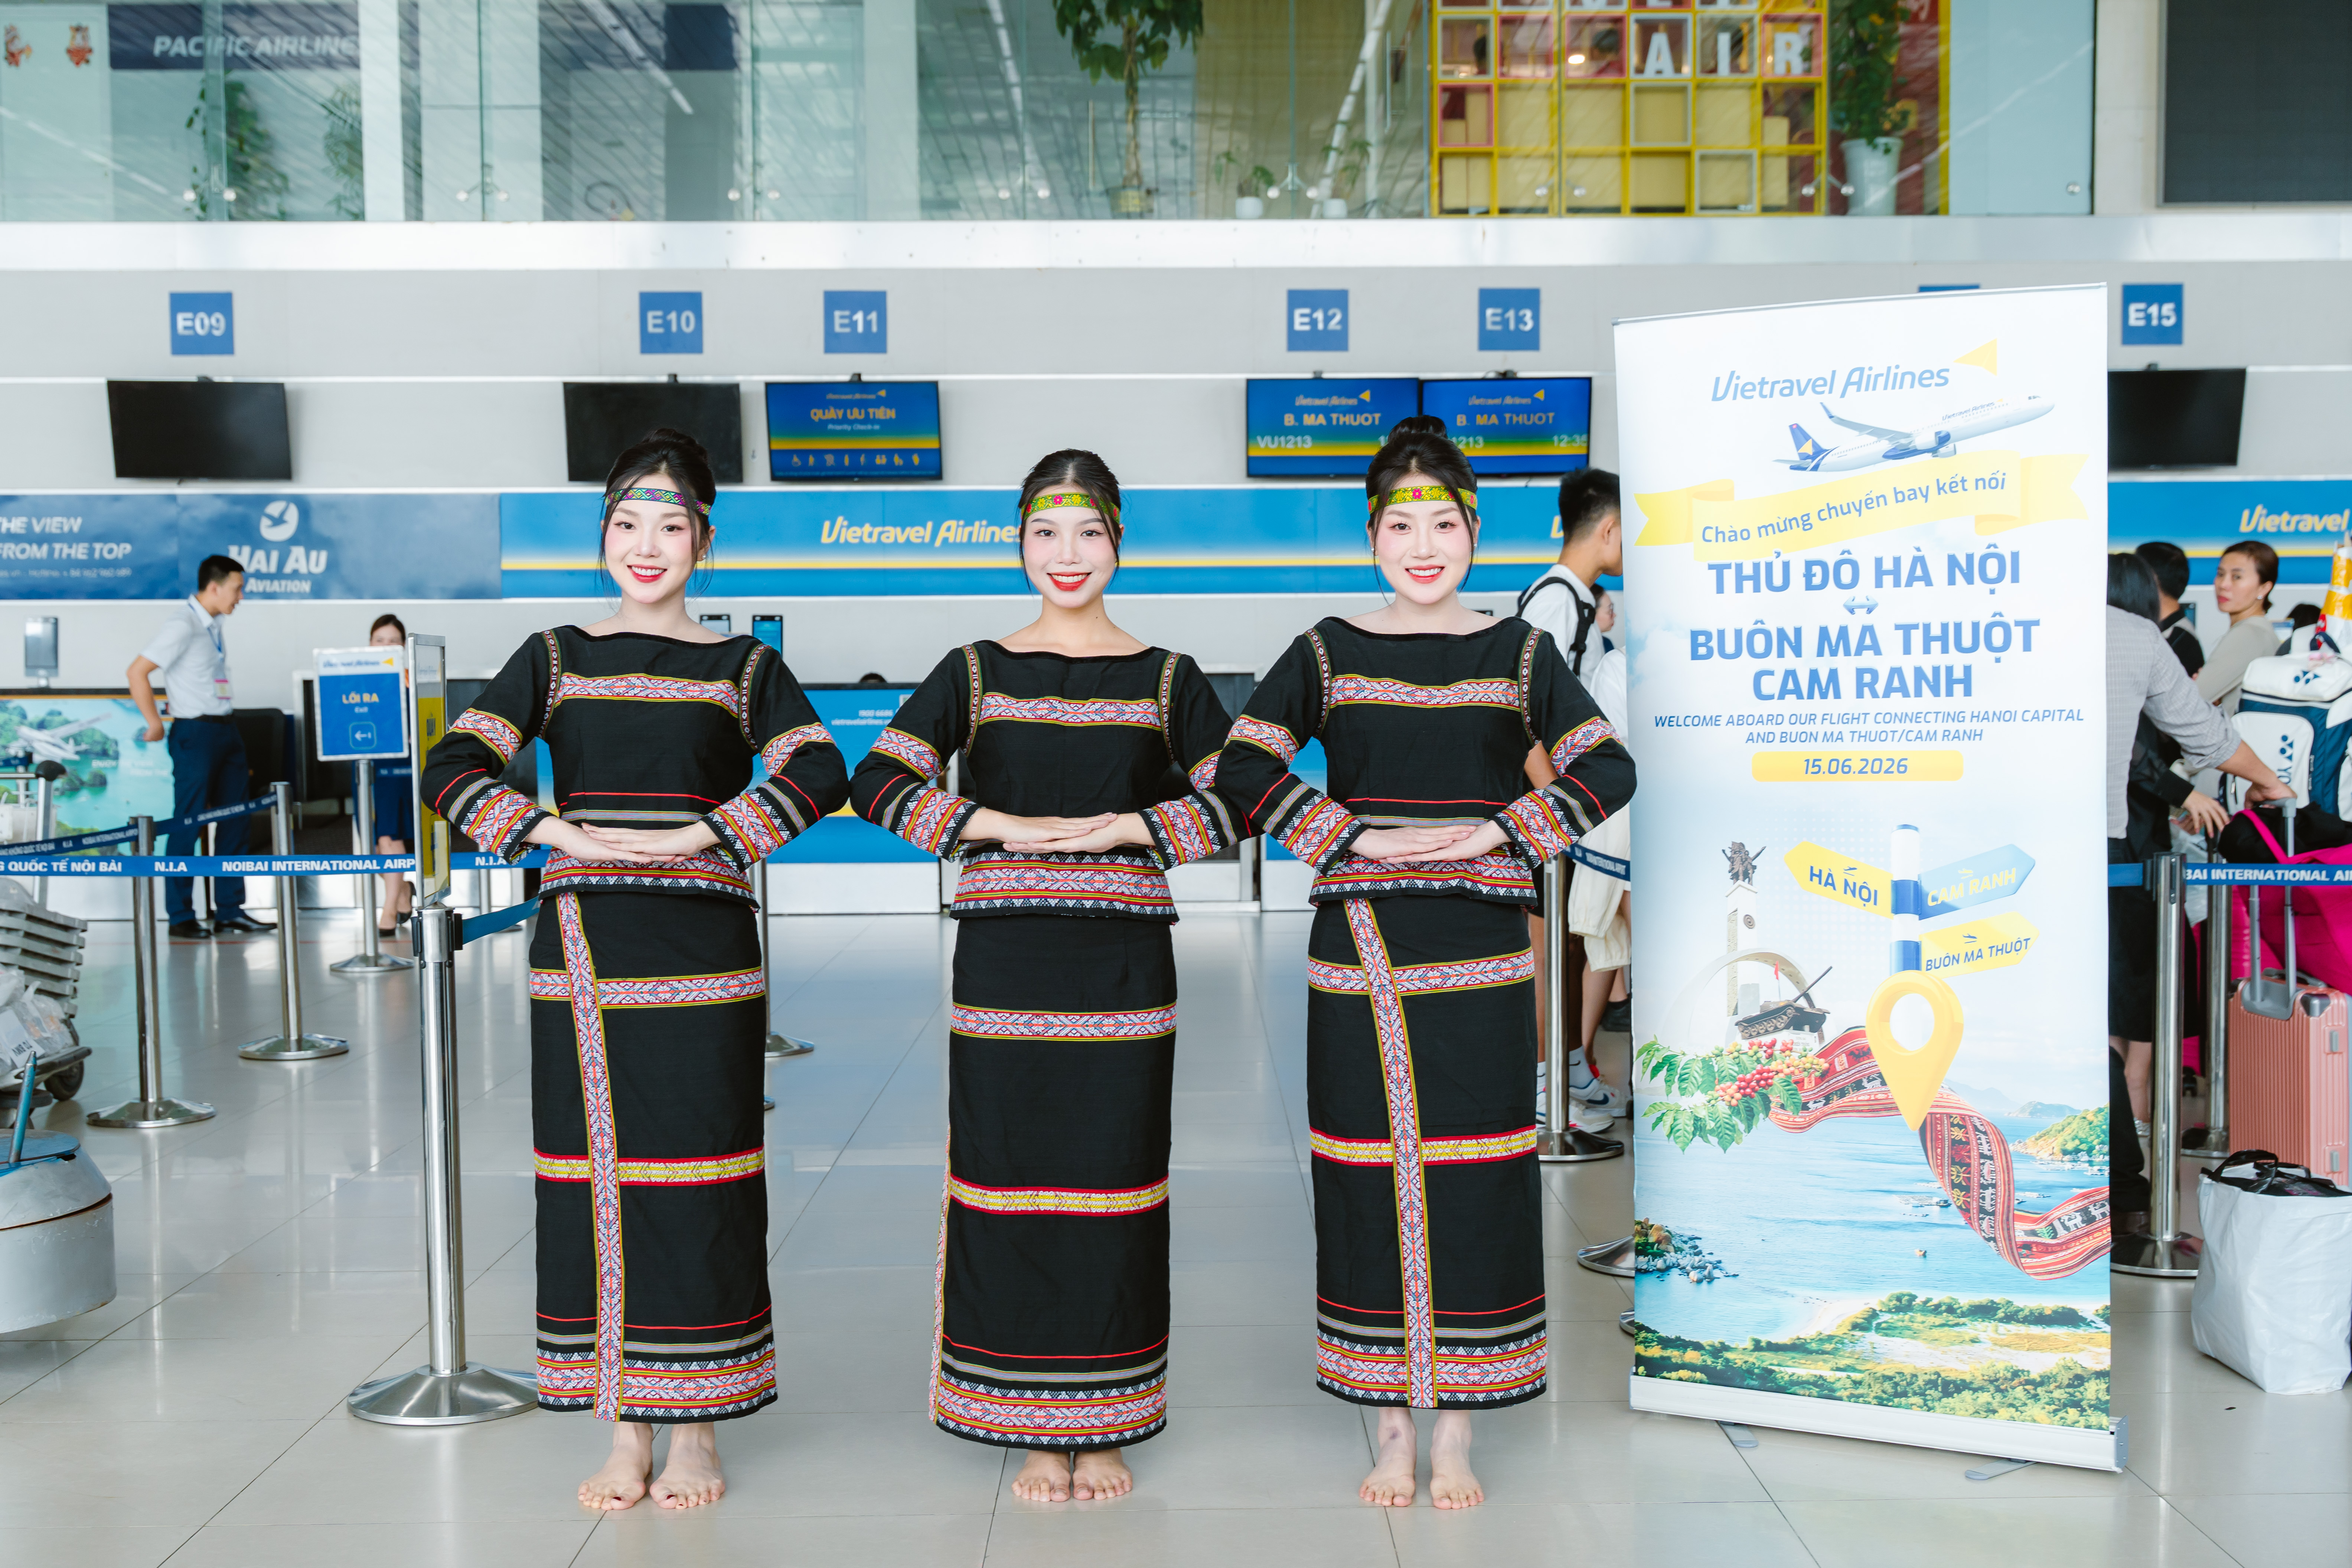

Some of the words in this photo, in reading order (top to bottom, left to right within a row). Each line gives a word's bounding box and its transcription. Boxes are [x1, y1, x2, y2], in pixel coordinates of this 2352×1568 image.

[153, 35, 249, 57] PACIFIC
[254, 36, 359, 57] AIRLINE
[176, 312, 226, 337] E09
[646, 310, 696, 334] E10
[833, 309, 878, 333] E11
[1293, 307, 1343, 331] E12
[1485, 307, 1534, 332] E13
[2127, 302, 2177, 327] E15
[1710, 369, 1837, 402] Vietravel
[1840, 364, 1950, 399] Airlines
[1283, 413, 1299, 426] B.
[1303, 413, 1327, 426] MA
[1330, 413, 1381, 426] THUOT
[1456, 414, 1470, 426] B.
[1475, 413, 1499, 426] MA
[1504, 412, 1555, 425] THUOT
[1256, 434, 1312, 449] VU1213
[1702, 525, 1751, 543] Chào
[1756, 512, 1814, 538] mừng
[1817, 489, 1888, 522] chuyến
[1893, 484, 1931, 504] bay
[1935, 473, 1969, 496] kết
[1974, 470, 2007, 492] nối
[2238, 503, 2351, 534] Vietravel
[0, 516, 29, 534] HE
[31, 516, 83, 534] VIEW
[821, 516, 933, 544] Vietravel
[52, 542, 90, 560] THE
[92, 542, 133, 560] TOP
[228, 545, 279, 574] HAI
[282, 545, 328, 574] AU
[1707, 550, 1791, 594] THỦ
[1803, 548, 1859, 591] ĐÔ
[1874, 545, 1934, 589] HÀ
[1947, 542, 2020, 595] NỘI
[244, 577, 312, 593] AVIATION
[1690, 619, 1803, 661] BUÔN
[1816, 623, 1883, 658] MA
[1894, 611, 2040, 663] THUỘT
[1753, 666, 1842, 701] CAM
[1855, 664, 1973, 699] RANH
[362, 692, 379, 703] RA
[1654, 714, 1722, 727] WELCOME
[1725, 714, 1785, 727] ABOARD
[1788, 713, 1817, 726] OUR
[1821, 712, 1870, 725] FLIGHT
[1873, 711, 1966, 724] CONNECTING
[1970, 710, 2018, 723] HANOI
[2021, 709, 2084, 722] CAPITAL
[1745, 731, 1776, 744] AND
[1779, 731, 1819, 743] BUON
[1821, 730, 1844, 743] MA
[1849, 729, 1938, 743] THUOT/CAM
[1941, 728, 1983, 741] RANH
[1803, 758, 1909, 775] 15.06.2026
[2277, 766, 2293, 785] YO
[8, 858, 48, 872] QUỐC
[51, 857, 69, 872] TẾ
[71, 859, 96, 875] NỘI
[99, 859, 122, 872] BÀI
[154, 861, 188, 872] N.I.A
[222, 860, 270, 872] NOIBAI
[272, 859, 381, 871] INTERNATIONAL
[384, 858, 415, 870] AIRP
[475, 856, 507, 866] N.I.A
[1809, 866, 1837, 891] HÀ
[1843, 878, 1878, 907] NỘI
[1927, 883, 1964, 907] CAM
[1969, 867, 2016, 896] RANH
[2211, 868, 2330, 882] INTERNATIONAL
[1925, 952, 1960, 972] BUÔN
[1963, 948, 1984, 963] MA
[1987, 937, 2032, 959] THUỘT
